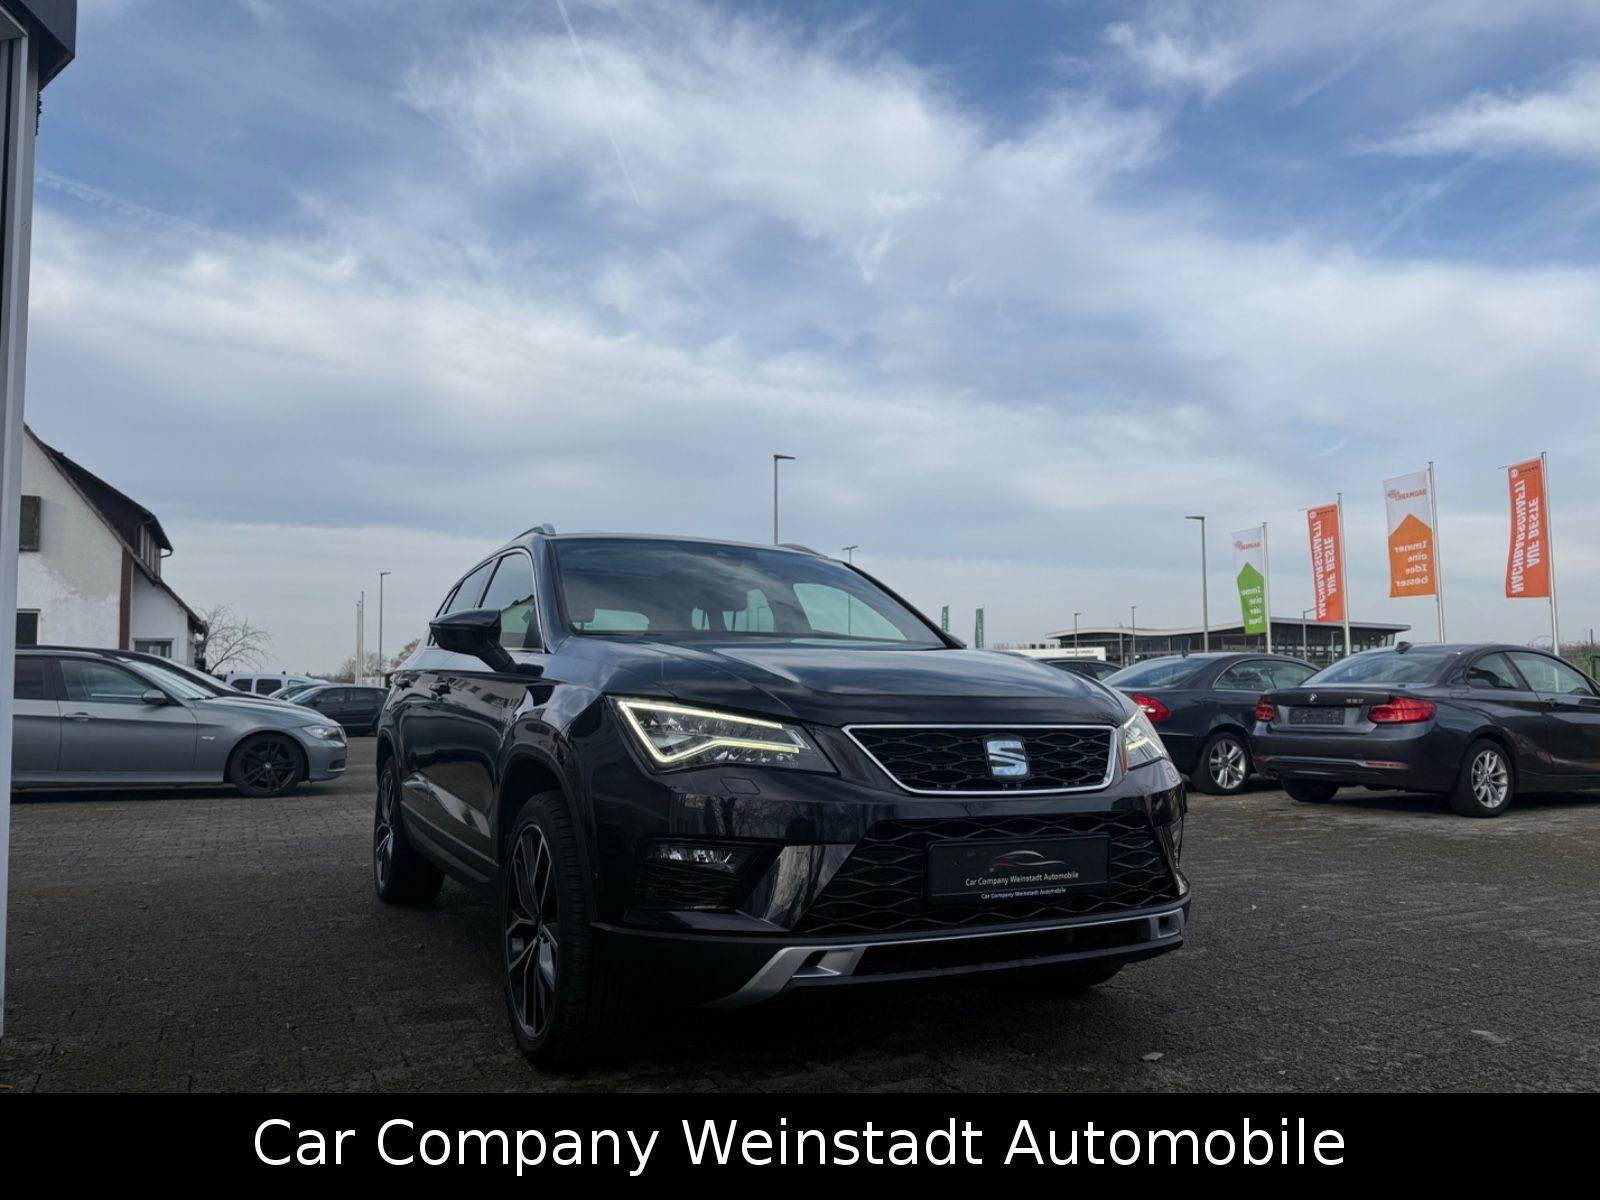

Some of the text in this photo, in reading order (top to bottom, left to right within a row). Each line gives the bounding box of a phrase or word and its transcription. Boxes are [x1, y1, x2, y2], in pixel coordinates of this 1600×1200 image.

[965, 871, 1079, 886] Car Company Weinstadt Automobile
